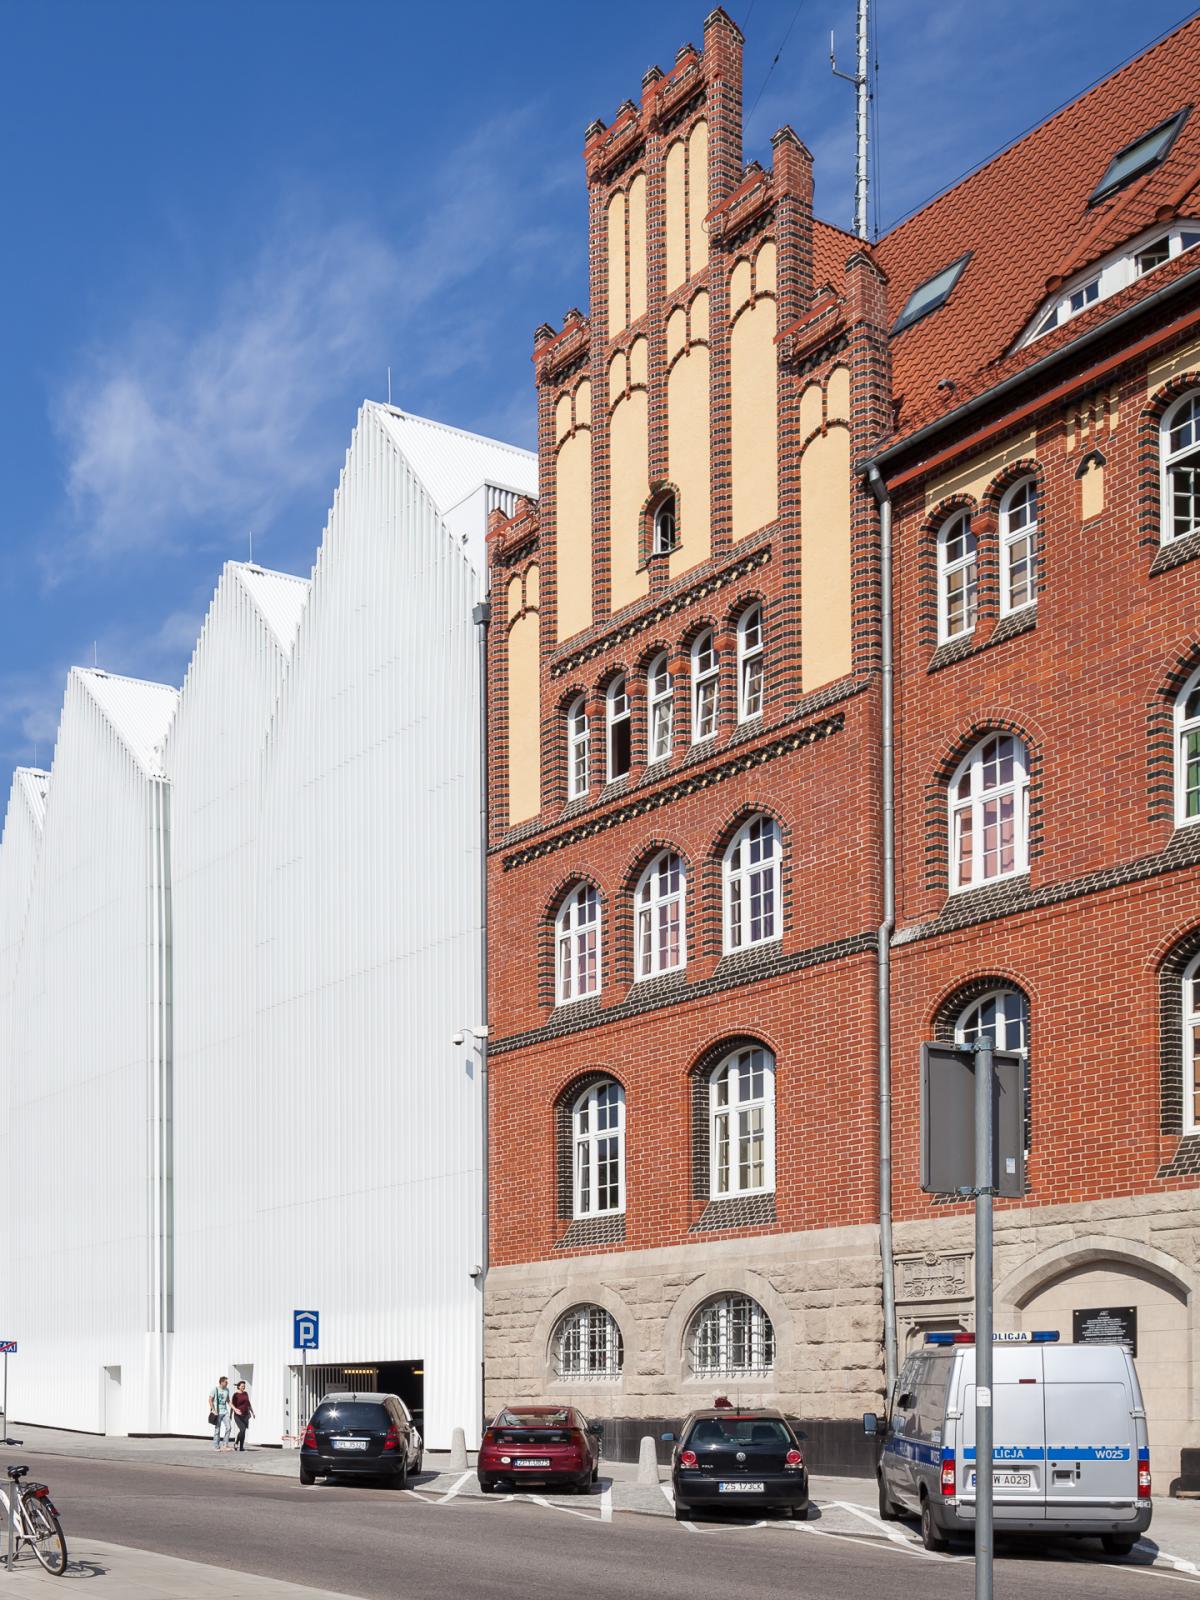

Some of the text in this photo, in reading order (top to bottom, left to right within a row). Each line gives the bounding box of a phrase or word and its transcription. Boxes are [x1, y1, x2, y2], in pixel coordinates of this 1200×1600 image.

[299, 1321, 314, 1345] P
[992, 1332, 1027, 1340] OLICJA
[994, 1449, 1024, 1458] LICJA
[1095, 1450, 1123, 1459] W025
[1004, 1475, 1028, 1485] A025
